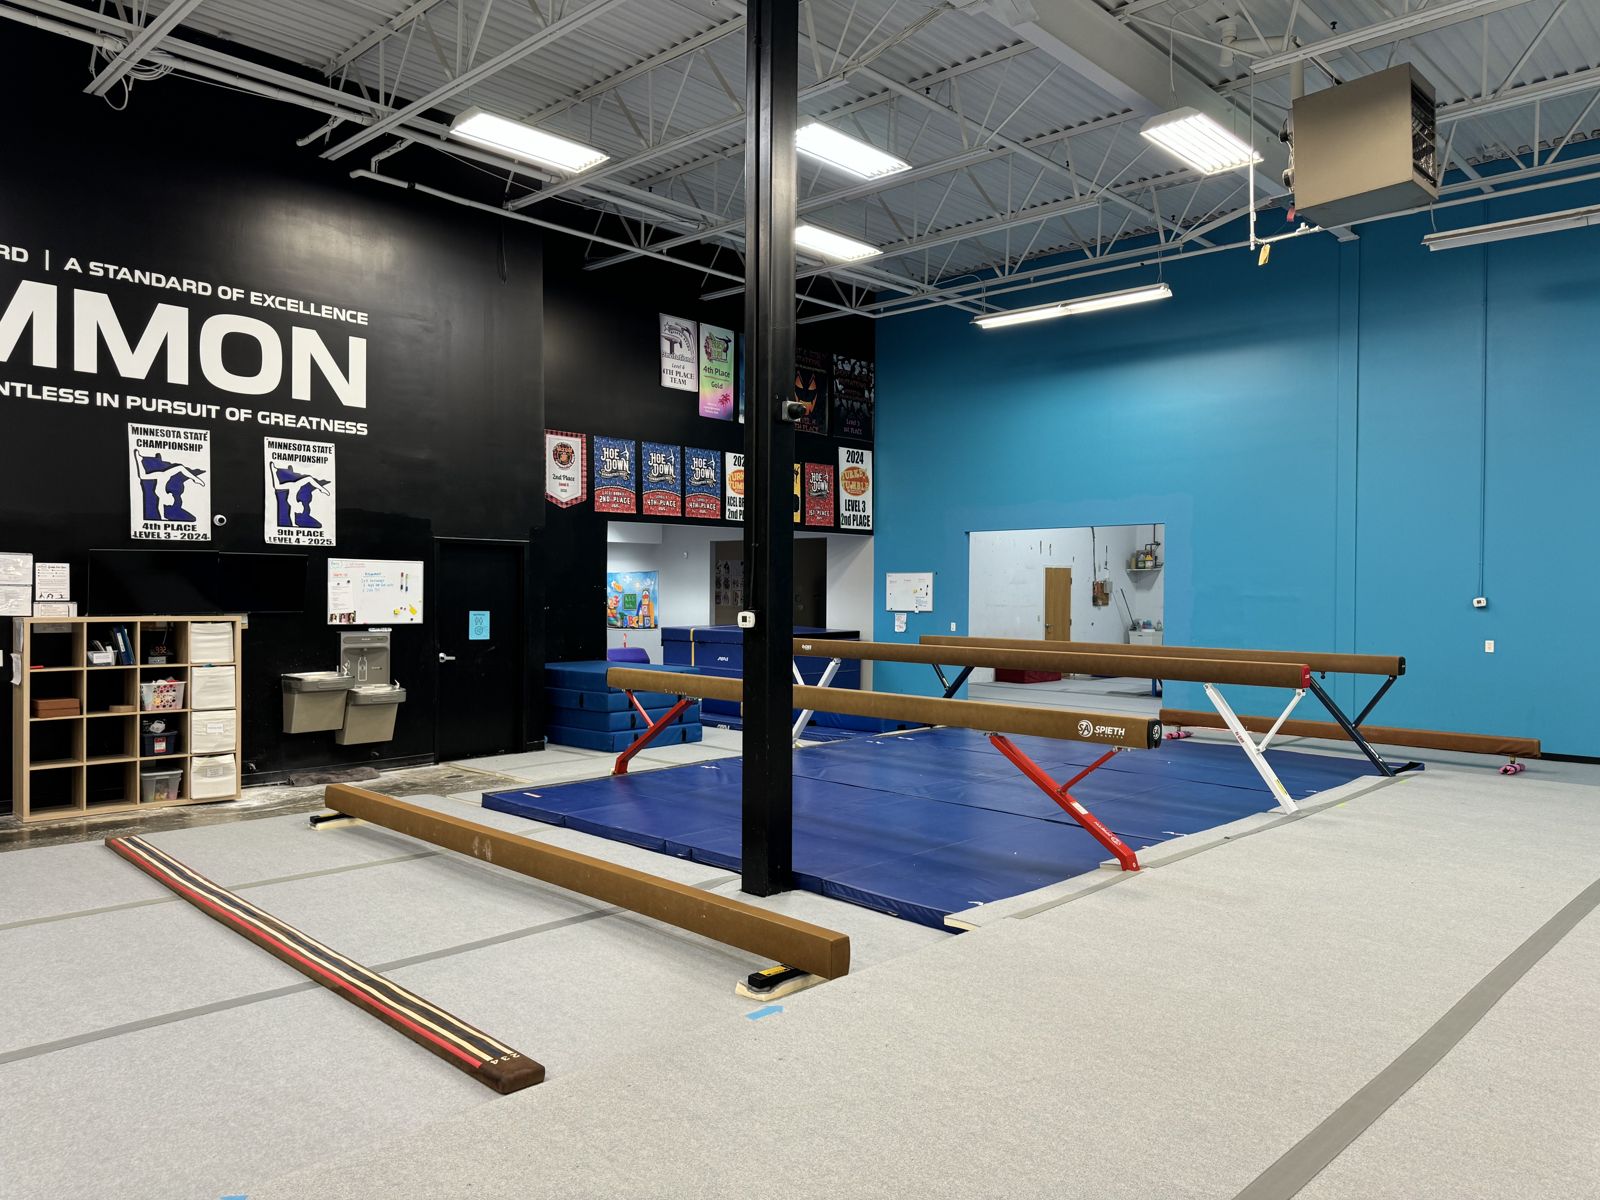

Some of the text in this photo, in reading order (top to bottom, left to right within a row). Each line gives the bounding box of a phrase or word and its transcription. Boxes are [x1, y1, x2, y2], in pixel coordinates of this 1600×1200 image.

[64, 257, 83, 273] A
[89, 261, 212, 297] STANDARD
[217, 285, 245, 302] OF
[250, 291, 369, 325] EXCELLENCE
[675, 369, 695, 380] PLACE
[703, 365, 731, 379] 4th Place
[670, 378, 687, 386] TEAM
[711, 381, 724, 389] Gold
[96, 392, 119, 408] IN
[126, 395, 220, 419] PURSUIT
[225, 407, 252, 422] OF
[257, 410, 368, 436] GREATNESS
[131, 426, 208, 442] MINNESOTA STATE
[136, 438, 203, 453] CHAMPIONSHIP
[267, 440, 333, 455] MINNESOTA STATE
[271, 452, 329, 465] CHAMPIONSHIP
[601, 447, 620, 461] HOE
[648, 452, 666, 466] HOE
[846, 449, 864, 465] 2024
[604, 457, 631, 473] DOWN
[651, 462, 676, 478] DOWN
[691, 457, 708, 470] HOE
[693, 467, 716, 482] DOWN
[810, 472, 823, 483] HOE
[599, 495, 631, 505] 2ND PLACE
[660, 500, 677, 508] PLACE
[844, 498, 866, 513] LEVEL 3
[701, 503, 716, 511] PLACE
[727, 508, 738, 519] 2nd
[142, 522, 198, 532] 4th PLACE
[841, 513, 871, 528] 2nd PLACE
[133, 530, 162, 539] LEVEL
[164, 532, 171, 540] 3
[180, 532, 208, 540] 2024
[277, 528, 325, 538] 9th PLACE
[268, 536, 293, 544] LEVEL
[1094, 725, 1125, 736] SPIETH
